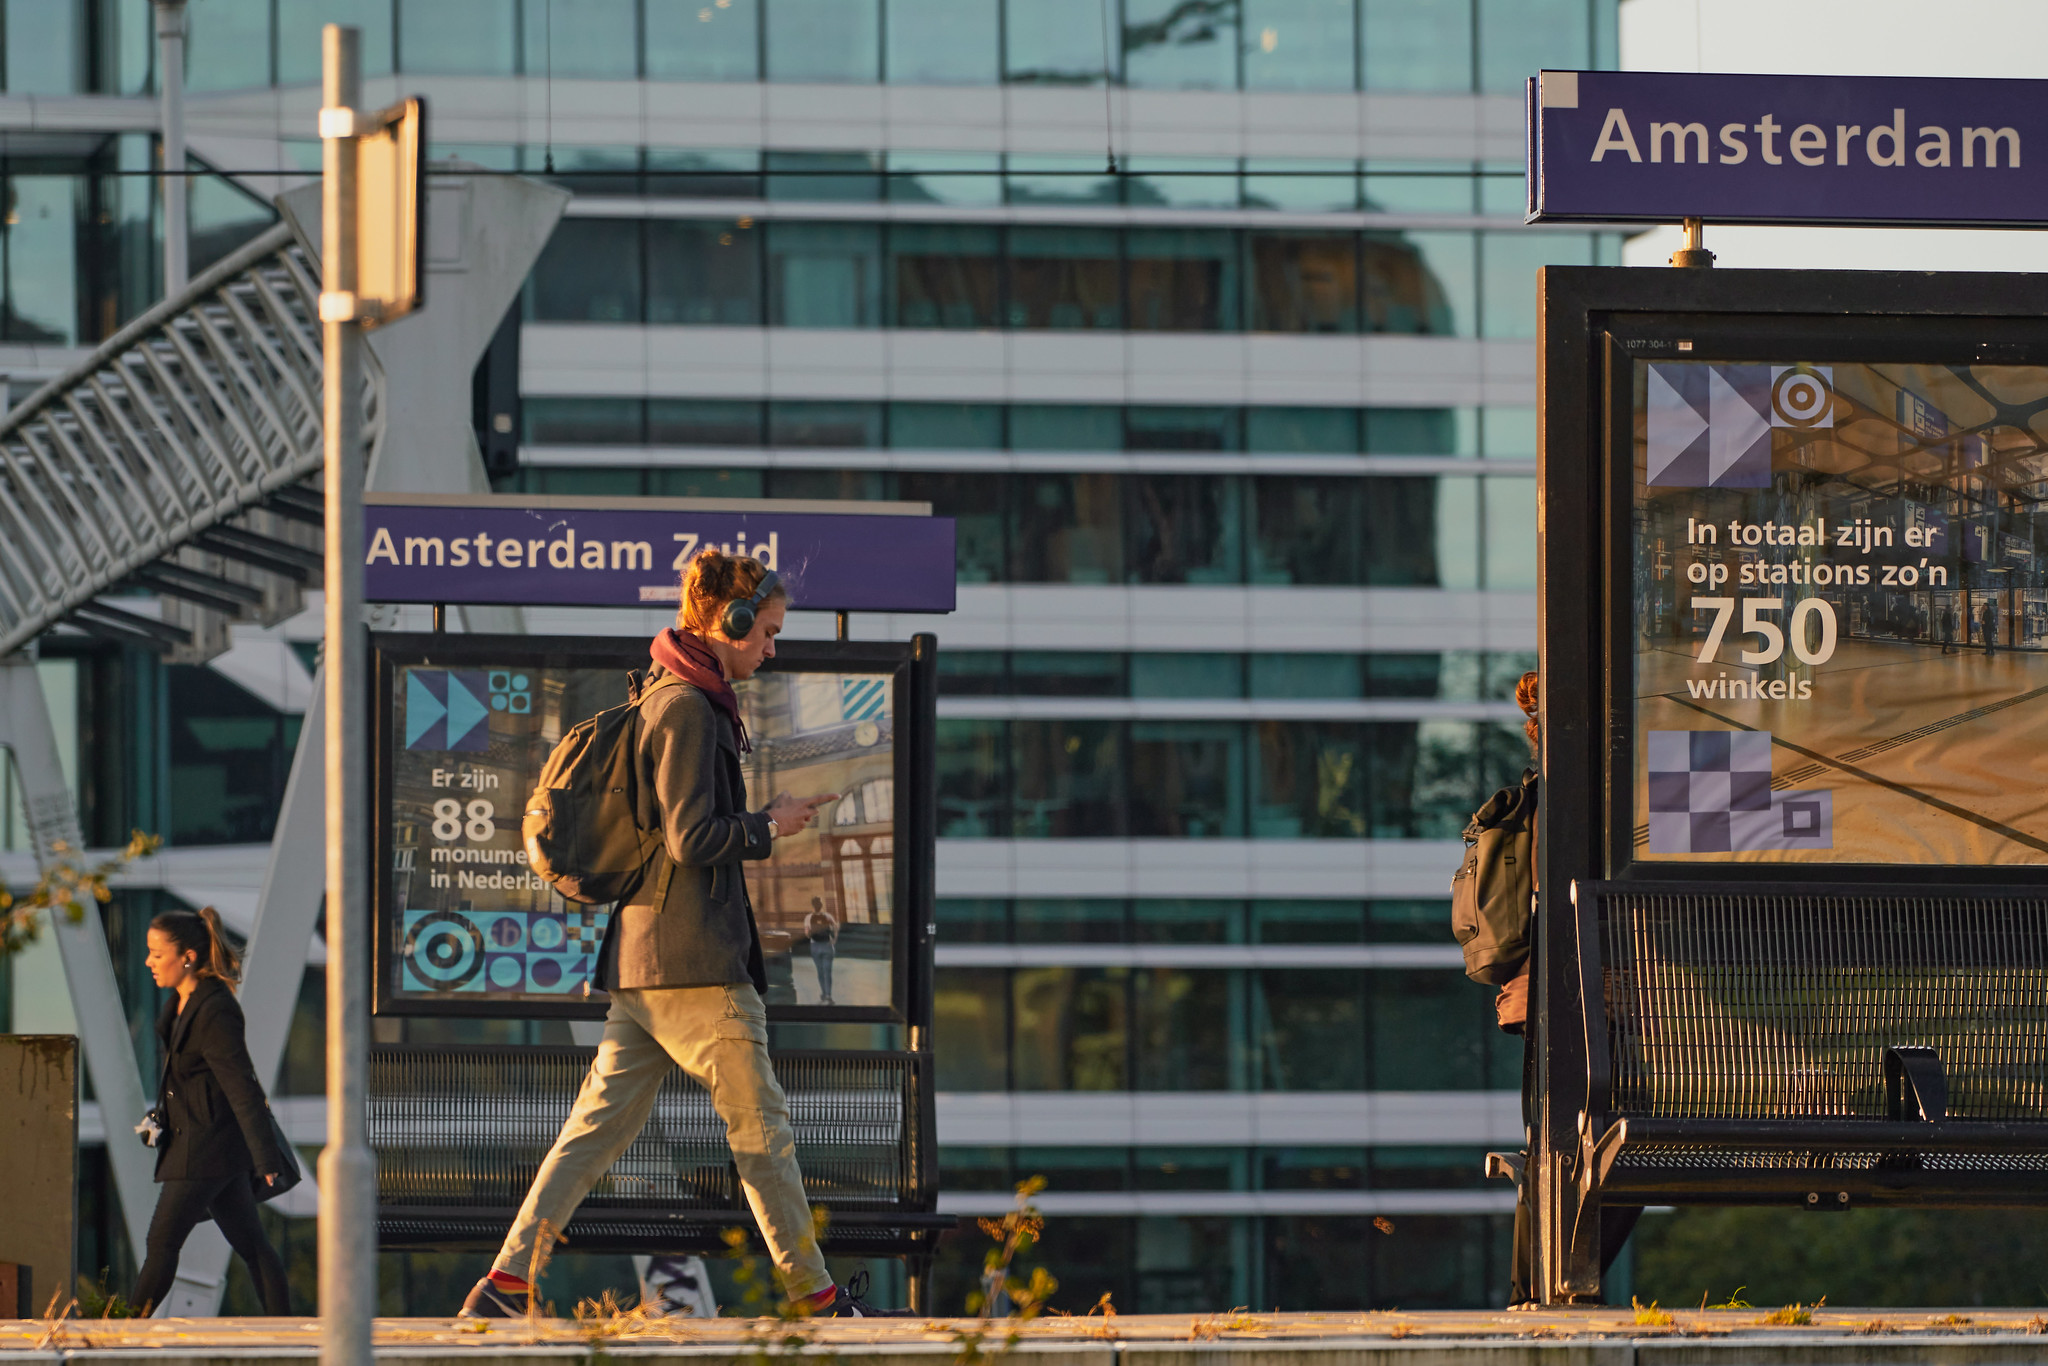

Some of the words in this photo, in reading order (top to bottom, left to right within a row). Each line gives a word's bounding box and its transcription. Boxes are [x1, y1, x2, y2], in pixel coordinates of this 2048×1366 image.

[1590, 108, 2021, 168] Amsterdam
[366, 527, 653, 571] Amsterdam
[1687, 518, 1717, 544] In
[1728, 518, 1825, 546] totaal
[1836, 519, 1893, 553] zijn
[1904, 526, 1937, 548] er
[1687, 562, 1728, 590] op
[1740, 557, 1870, 585] stations
[1690, 597, 1838, 665] 750
[1686, 672, 1812, 700] winkels
[432, 769, 454, 787] Er
[461, 769, 498, 792] zijn
[431, 799, 495, 842] 88
[430, 847, 528, 865] monume
[430, 869, 450, 889] in
[458, 869, 552, 890] Nederla
